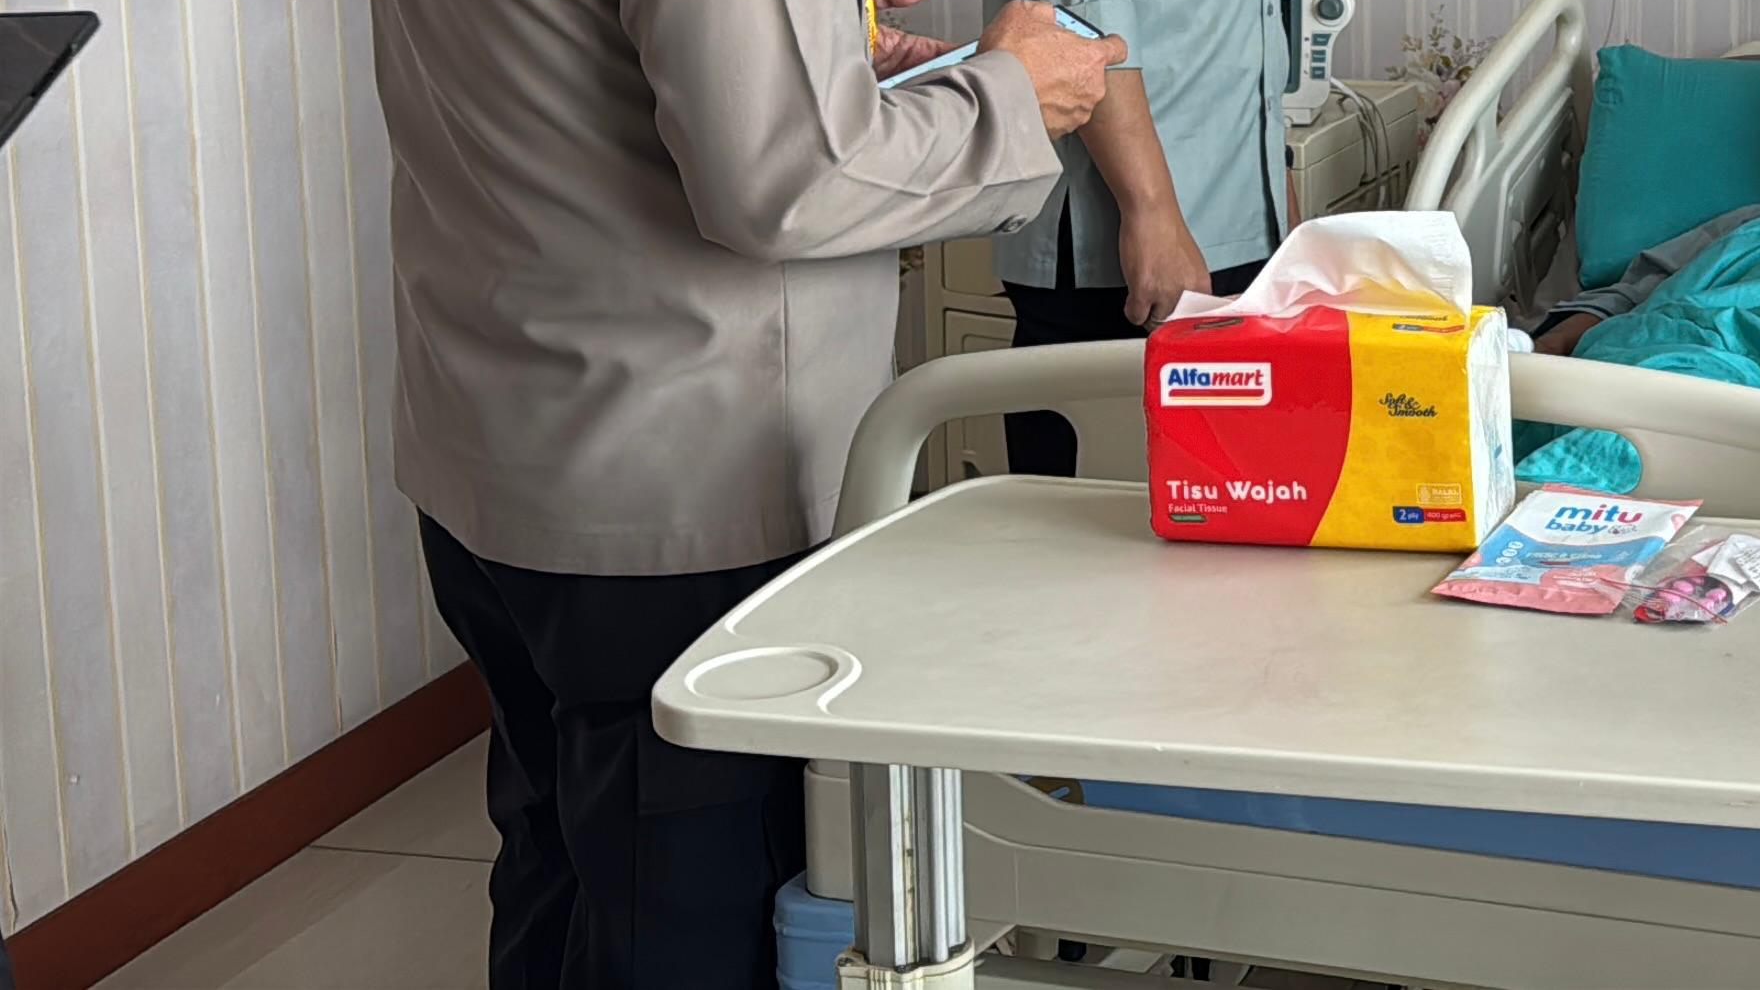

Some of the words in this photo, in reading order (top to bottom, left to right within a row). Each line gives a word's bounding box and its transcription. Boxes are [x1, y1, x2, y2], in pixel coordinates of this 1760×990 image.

[1168, 368, 1264, 386] Alfamart
[1389, 405, 1438, 417] Smooth
[1166, 480, 1218, 500] Tisu
[1226, 480, 1307, 504] Wajah
[1168, 504, 1196, 513] Facial
[1198, 504, 1228, 514] Tissue
[1399, 509, 1407, 521] 2
[1554, 504, 1643, 523] mitu
[1545, 519, 1609, 534] baby
